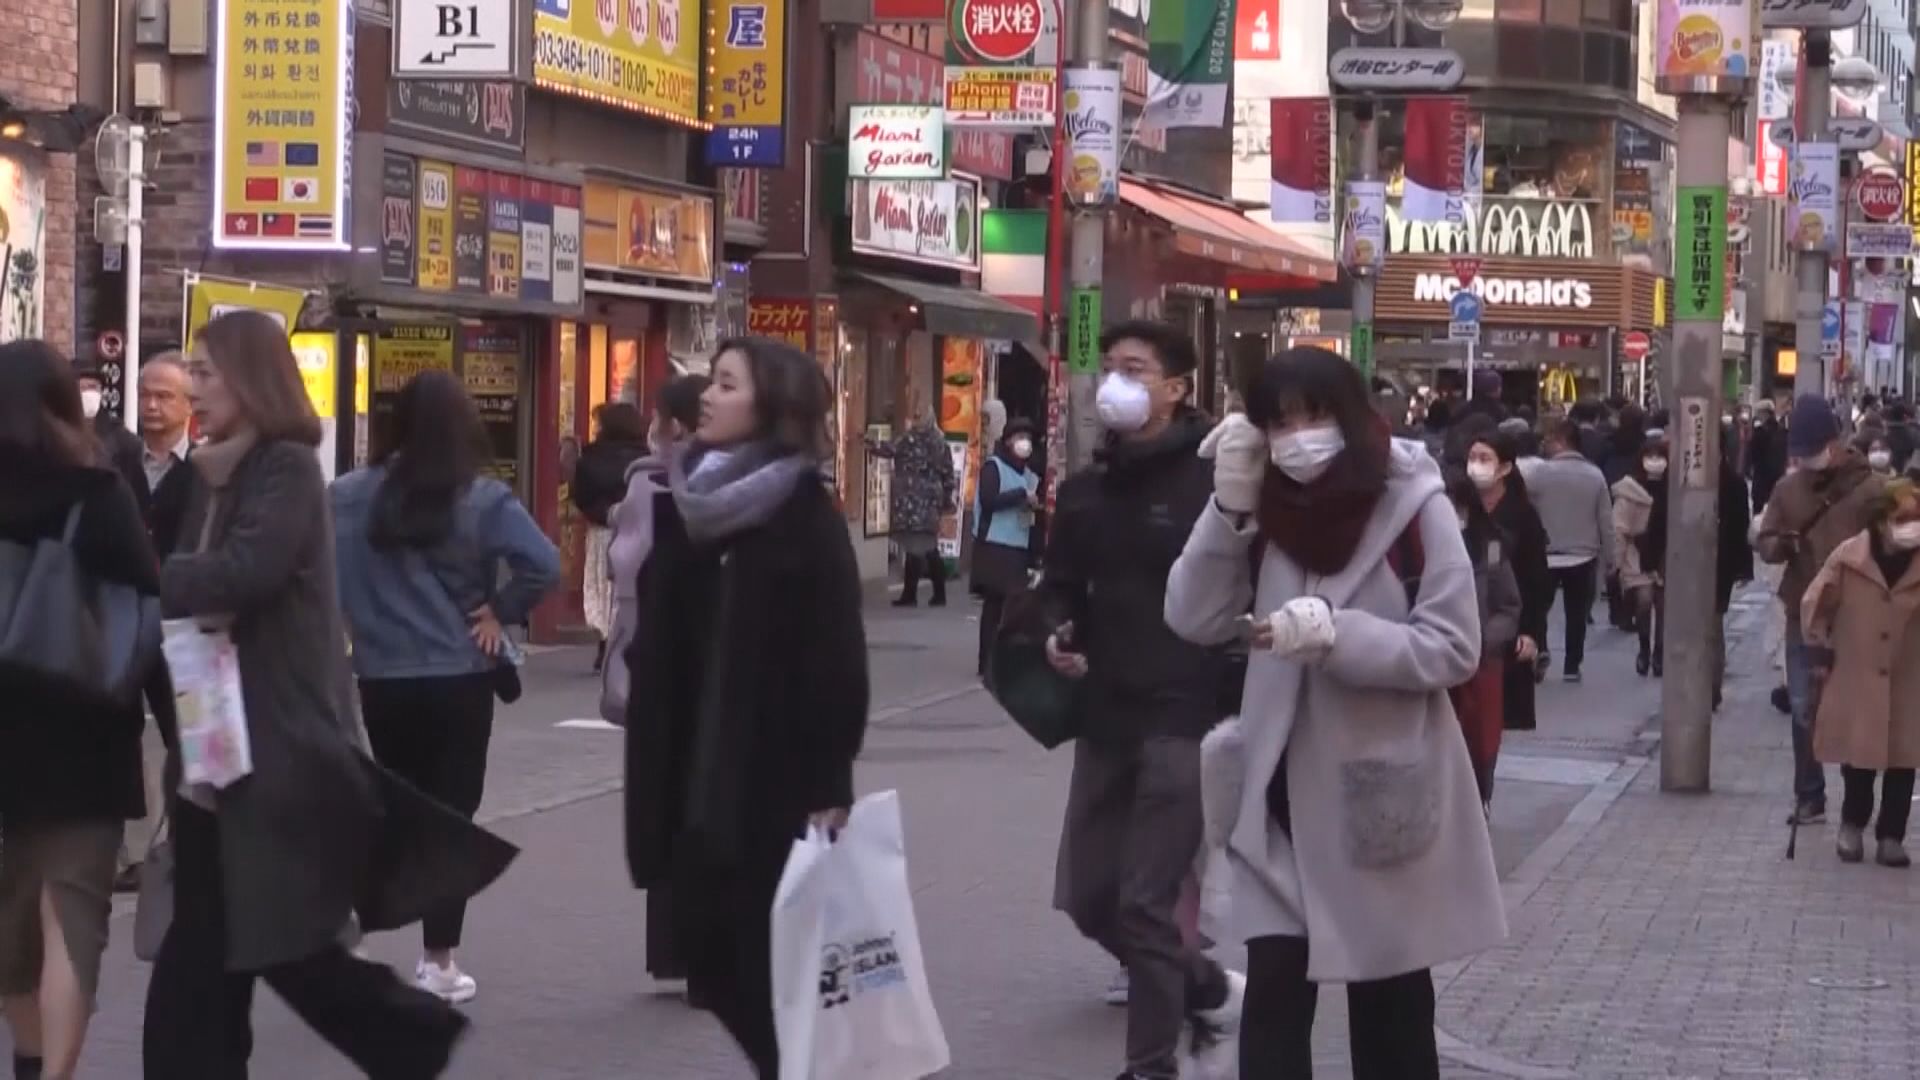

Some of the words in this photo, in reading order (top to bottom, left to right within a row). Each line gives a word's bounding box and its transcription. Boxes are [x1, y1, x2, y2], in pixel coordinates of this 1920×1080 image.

[438, 6, 477, 36] B1
[656, 5, 679, 43] No.1
[726, 7, 766, 47] 屋
[972, 6, 1035, 35] 消火栓
[538, 31, 613, 82] 03-3464-1011
[1338, 59, 1455, 75] 渋谷センター街
[739, 69, 751, 111] カレー
[753, 62, 767, 105] 牛めし
[728, 127, 758, 140] 24h
[732, 146, 753, 159] 1F
[853, 124, 922, 142] Miami
[1313, 101, 1328, 167] TOKYO
[1446, 101, 1466, 167] TOKYO
[865, 150, 940, 174] garden
[874, 187, 913, 231] Miami
[1313, 170, 1330, 222] 2020
[1444, 170, 1465, 223] 2020
[1691, 195, 1713, 312] 客引きは犯罪です
[1414, 274, 1593, 308] McDonald's
